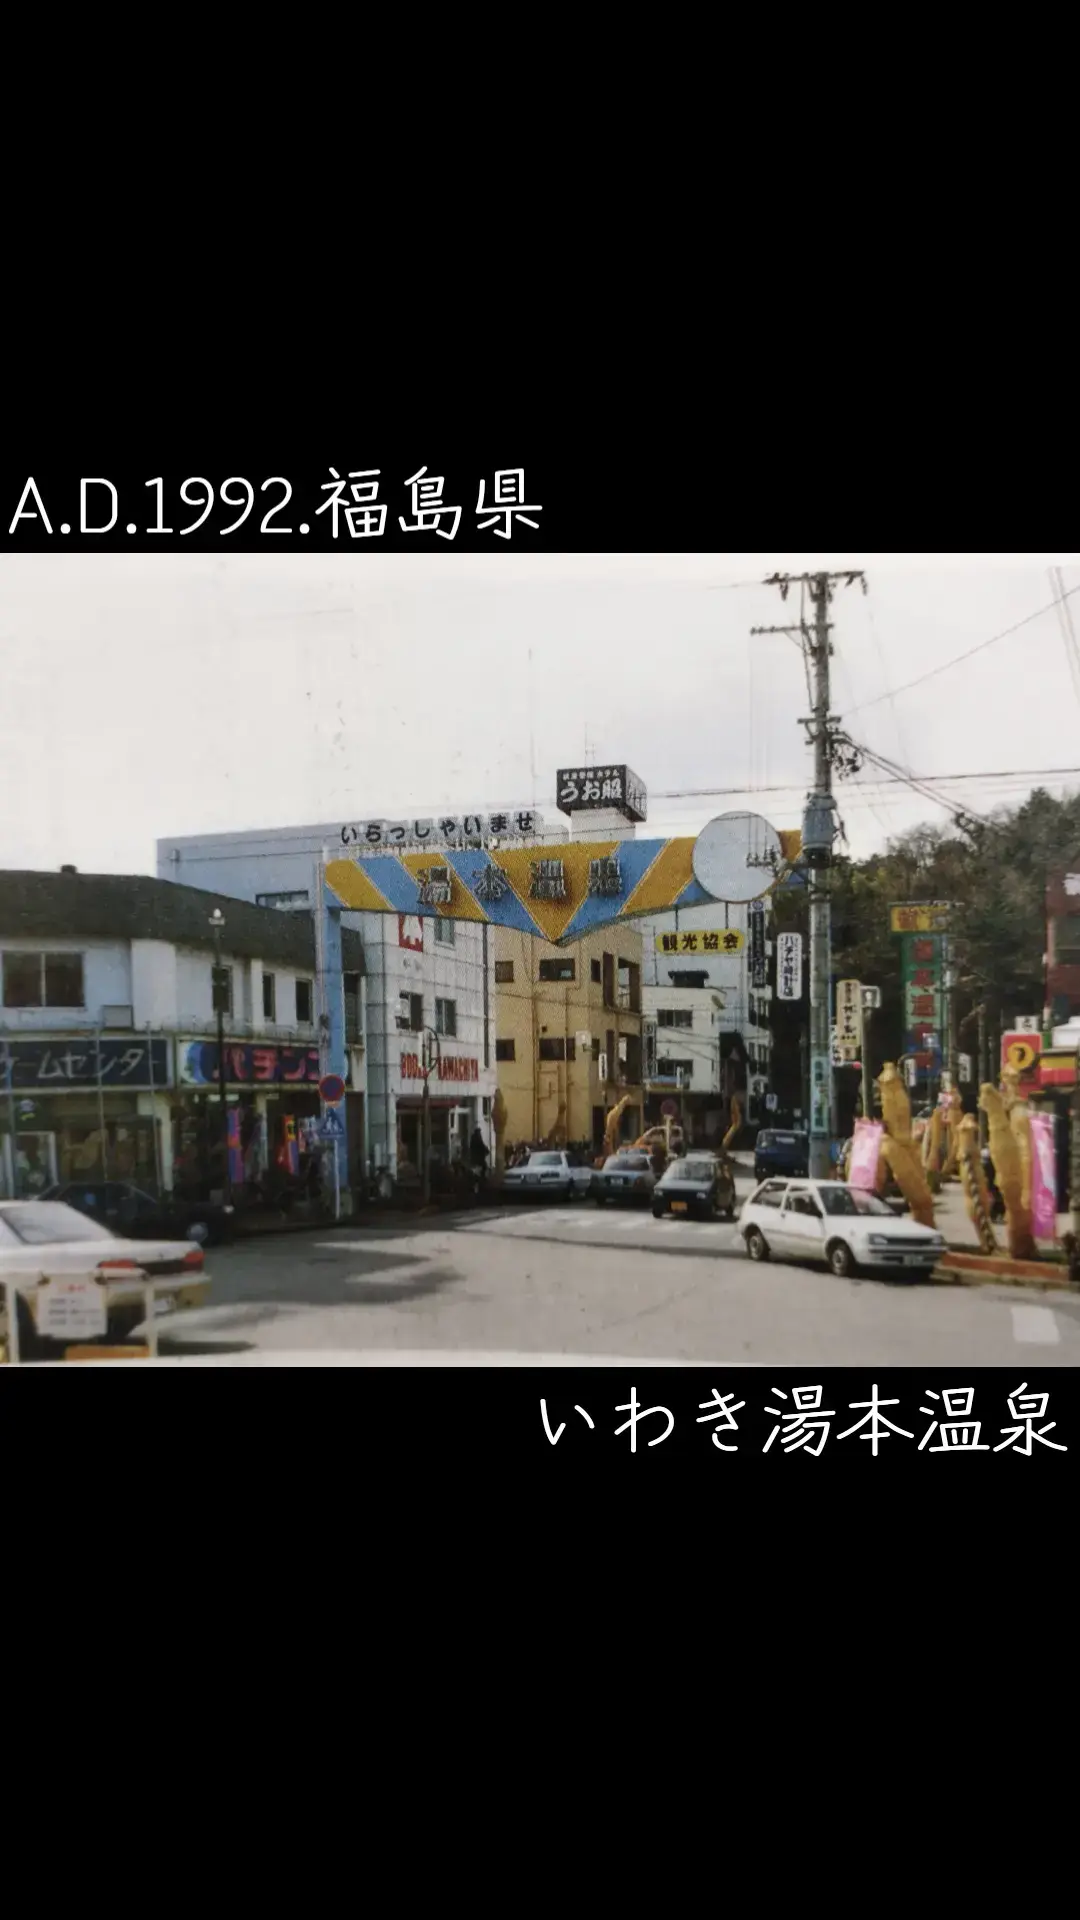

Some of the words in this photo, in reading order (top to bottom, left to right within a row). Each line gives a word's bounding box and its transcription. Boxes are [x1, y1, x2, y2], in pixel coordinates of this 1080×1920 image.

[341, 812, 533, 845] いらっしゃいませ
[662, 931, 739, 951] 観光協会
